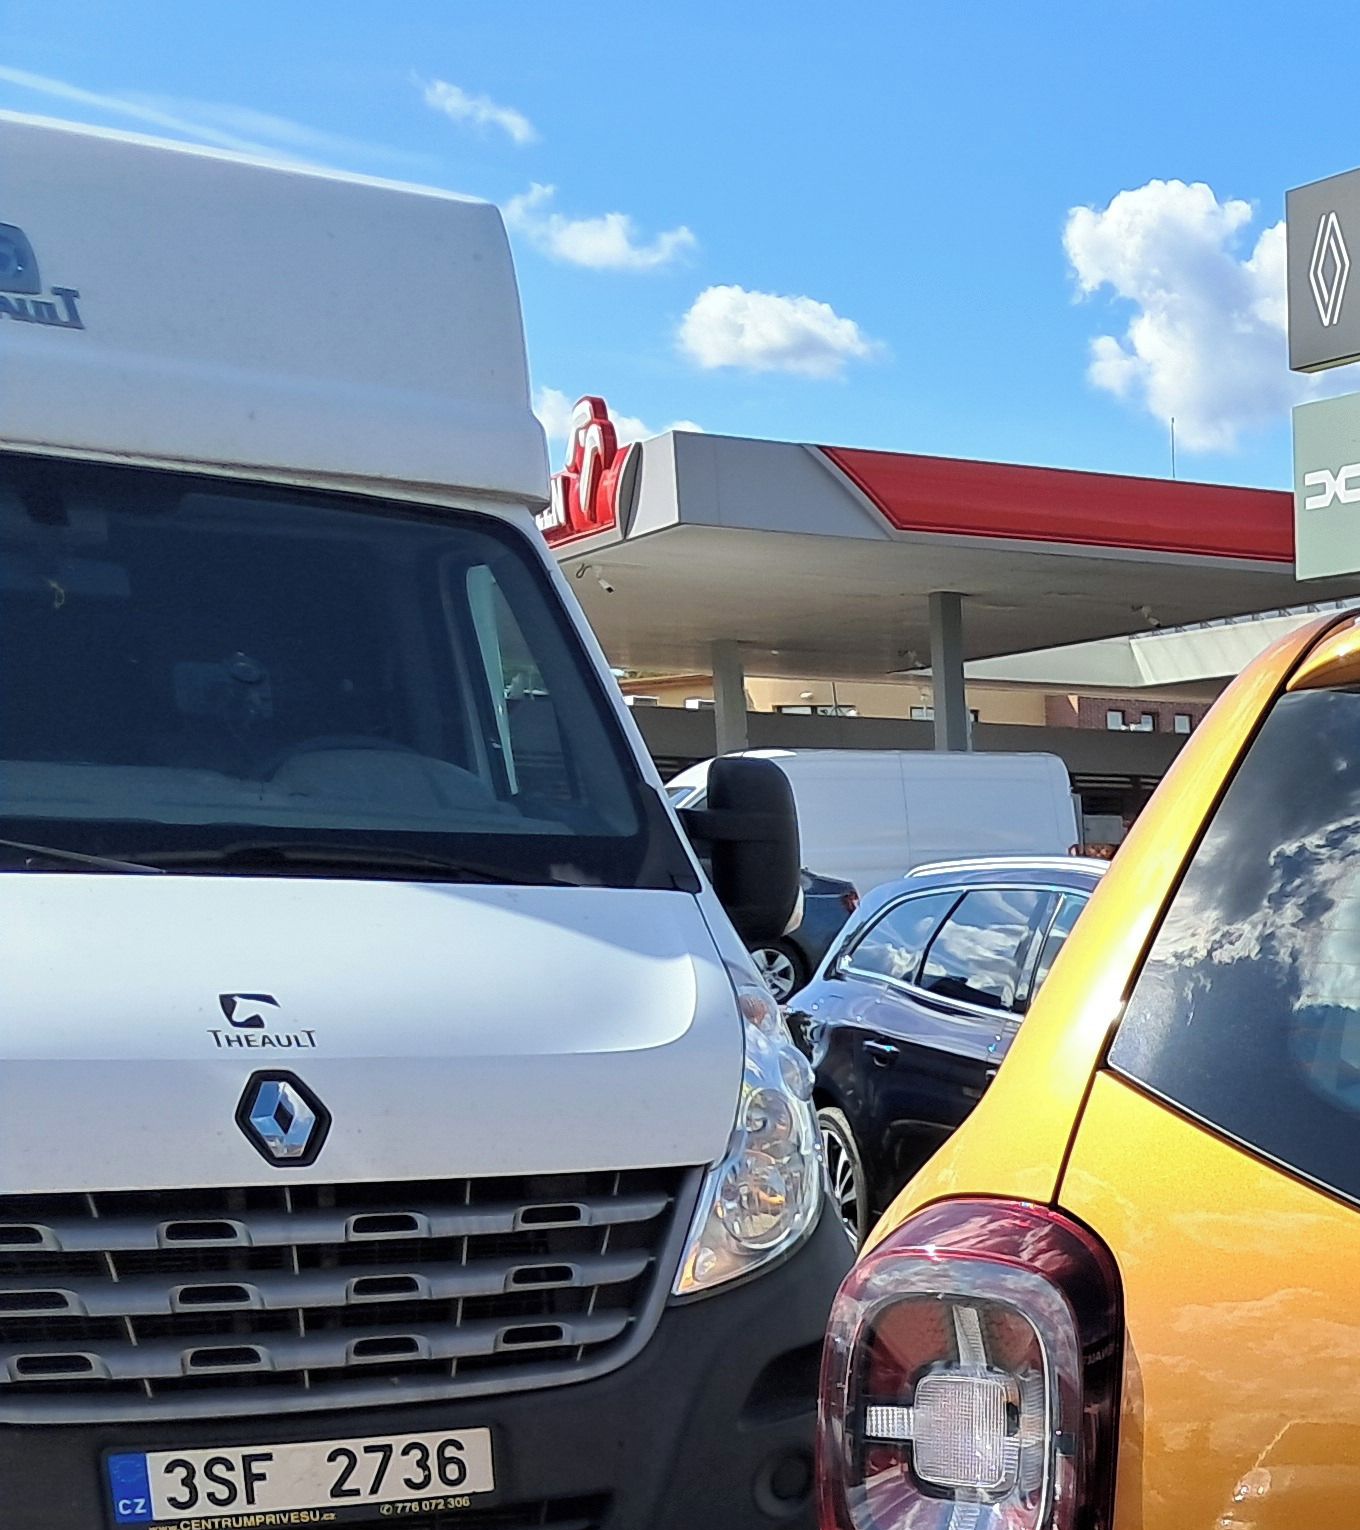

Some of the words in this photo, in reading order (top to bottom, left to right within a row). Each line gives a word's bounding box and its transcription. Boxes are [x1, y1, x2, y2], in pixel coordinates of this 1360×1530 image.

[206, 1029, 317, 1048] THEAULT
[163, 1452, 274, 1511] 3SF
[326, 1438, 468, 1499] 2736
[118, 1499, 148, 1516] CZ
[395, 1502, 420, 1514] 776
[421, 1499, 445, 1511] 072
[447, 1496, 471, 1509] 306
